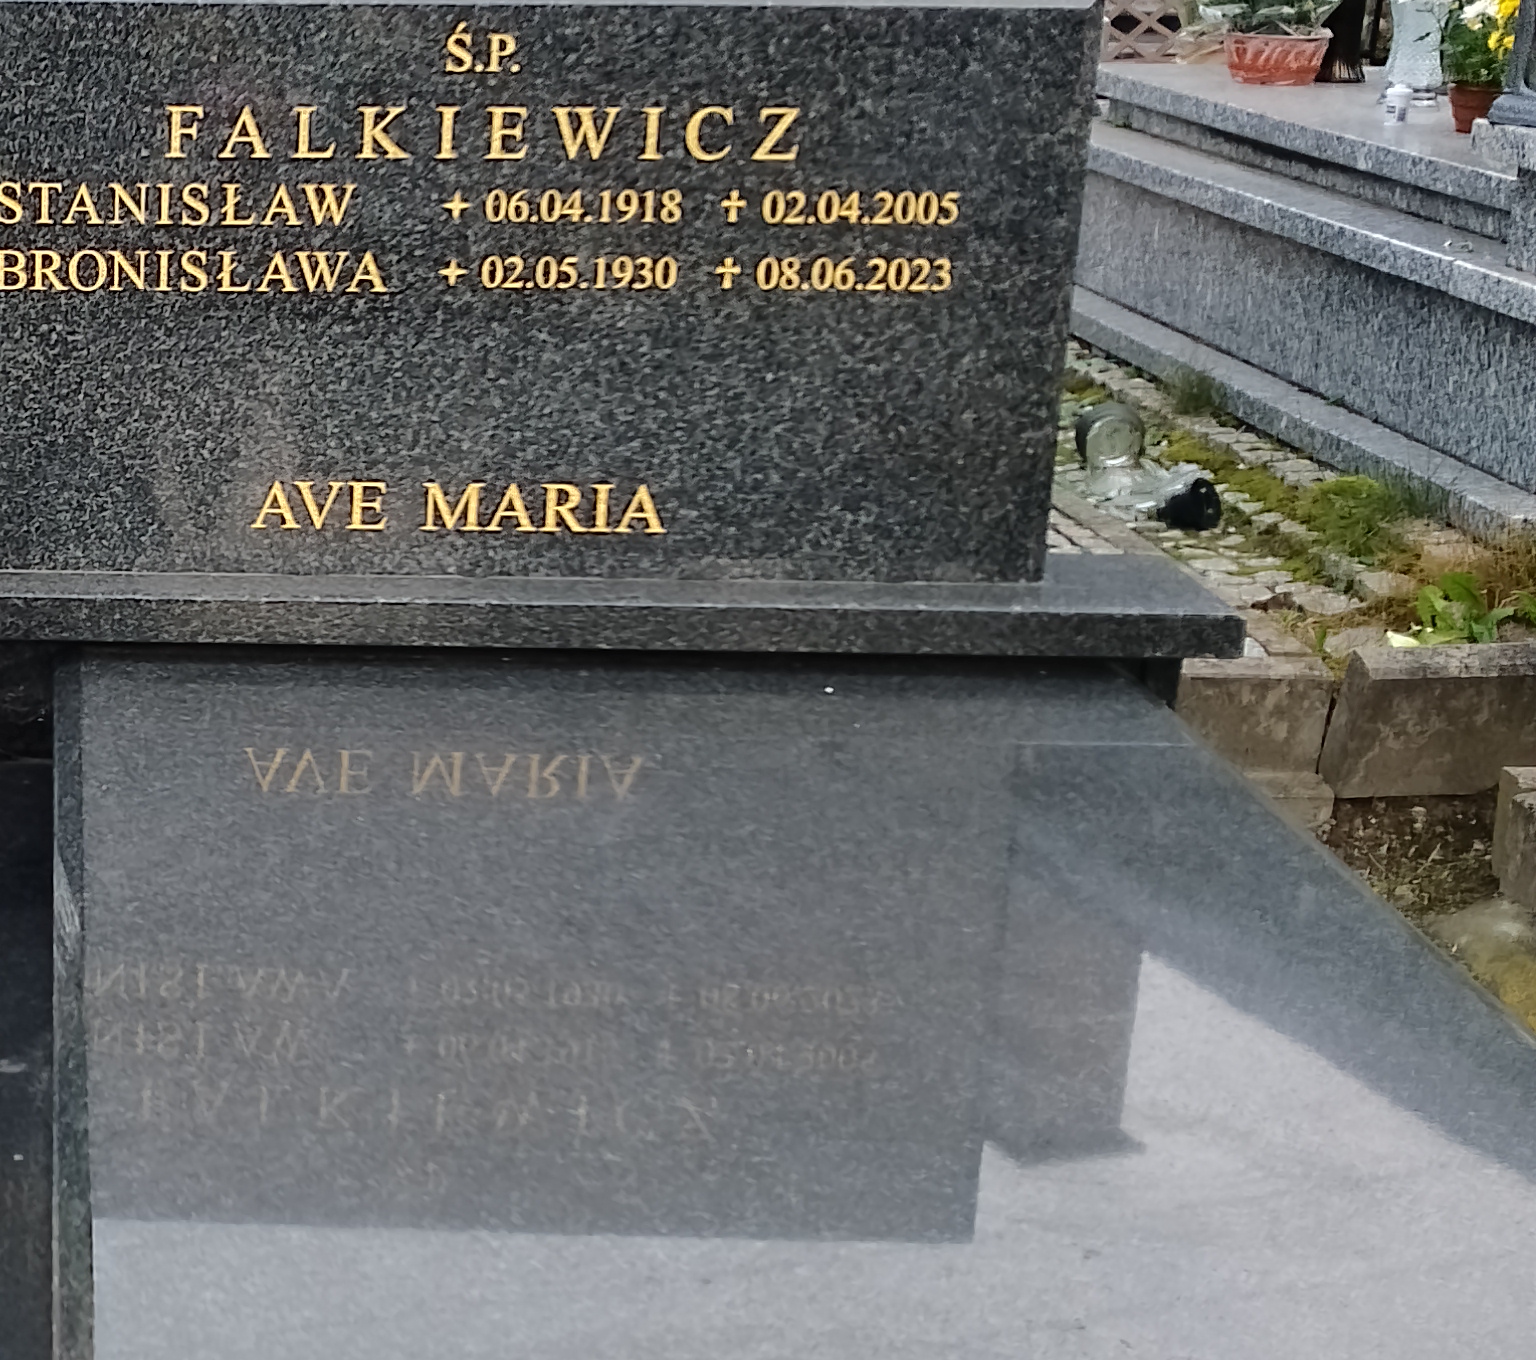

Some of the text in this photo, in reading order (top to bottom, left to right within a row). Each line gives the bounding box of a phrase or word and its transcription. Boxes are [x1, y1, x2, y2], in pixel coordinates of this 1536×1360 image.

[445, 21, 521, 74] Ś.P.
[164, 105, 802, 162] FALKIEWICZ
[484, 189, 684, 225] 06.04.1918
[761, 190, 961, 227] 02.04.2005
[479, 256, 679, 292] 02.05.1930
[755, 257, 953, 293] 08.06.2023
[251, 480, 667, 536] AVE MARIA
